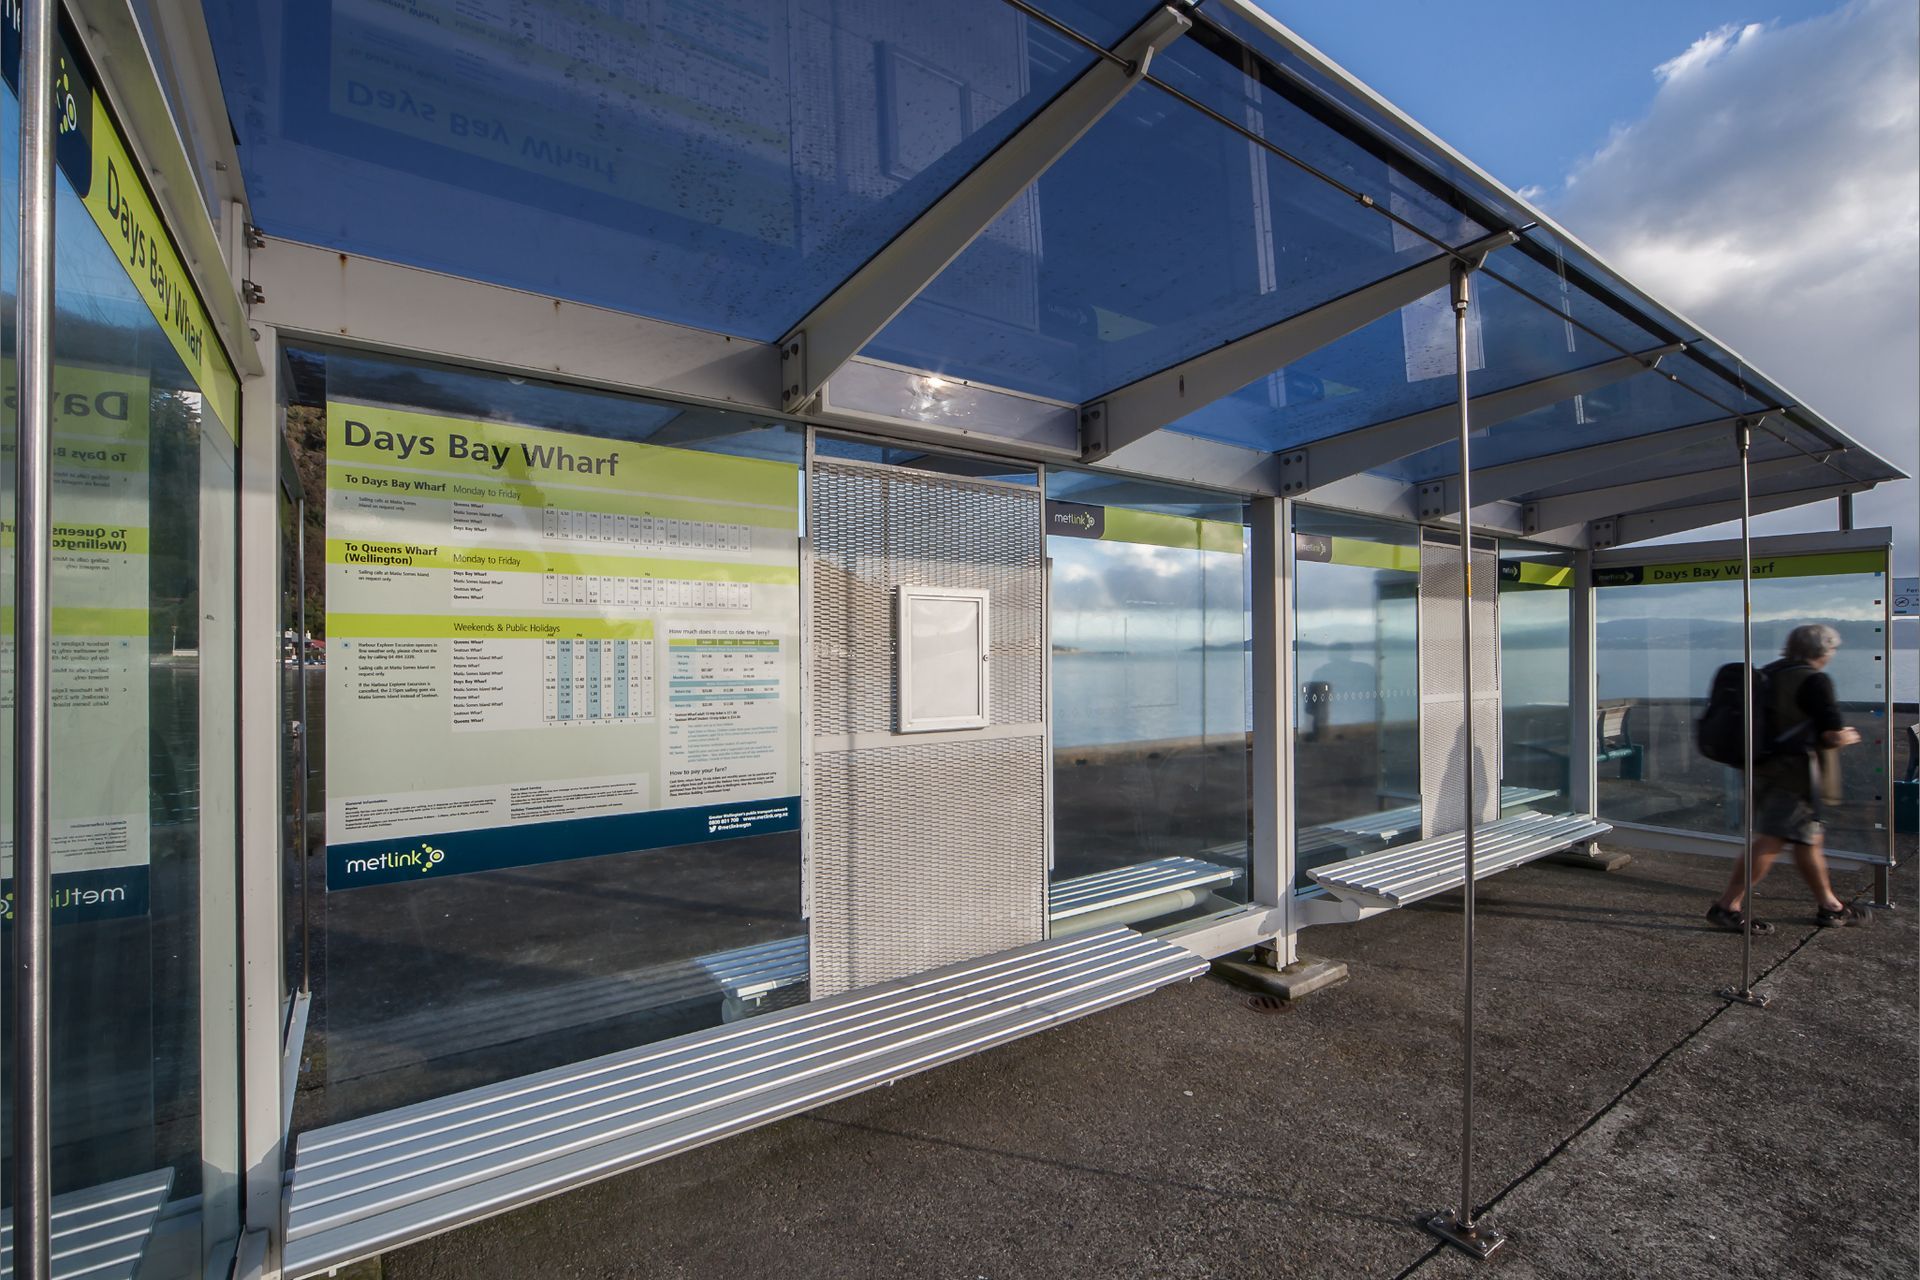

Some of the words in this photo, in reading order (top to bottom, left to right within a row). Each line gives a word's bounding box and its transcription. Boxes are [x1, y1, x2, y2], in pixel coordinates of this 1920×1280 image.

[108, 155, 146, 269] Days
[150, 235, 171, 322] Bay
[174, 282, 202, 366] Wharf
[344, 420, 434, 460] Days
[449, 434, 510, 469] Bay
[519, 443, 619, 476] Wharf
[345, 474, 358, 483] To
[362, 476, 388, 487] Days
[392, 479, 410, 490] Bay
[414, 481, 446, 492] Wharf
[454, 485, 486, 497] Monday
[488, 489, 496, 497] to
[498, 490, 521, 501] Friday
[1054, 513, 1085, 525] metlink
[345, 543, 358, 551] To
[362, 544, 402, 554] Queens
[405, 546, 438, 556] Wharf
[345, 553, 413, 566] (Wellington)
[453, 554, 485, 565] Monday
[498, 557, 520, 567] Friday
[1654, 570, 1688, 581] Days
[1693, 567, 1719, 578] Bay
[1725, 562, 1775, 575] Warf
[453, 623, 494, 631] Weekends
[506, 624, 528, 632] Public
[530, 624, 560, 634] Holidays
[345, 850, 422, 873] metlink
